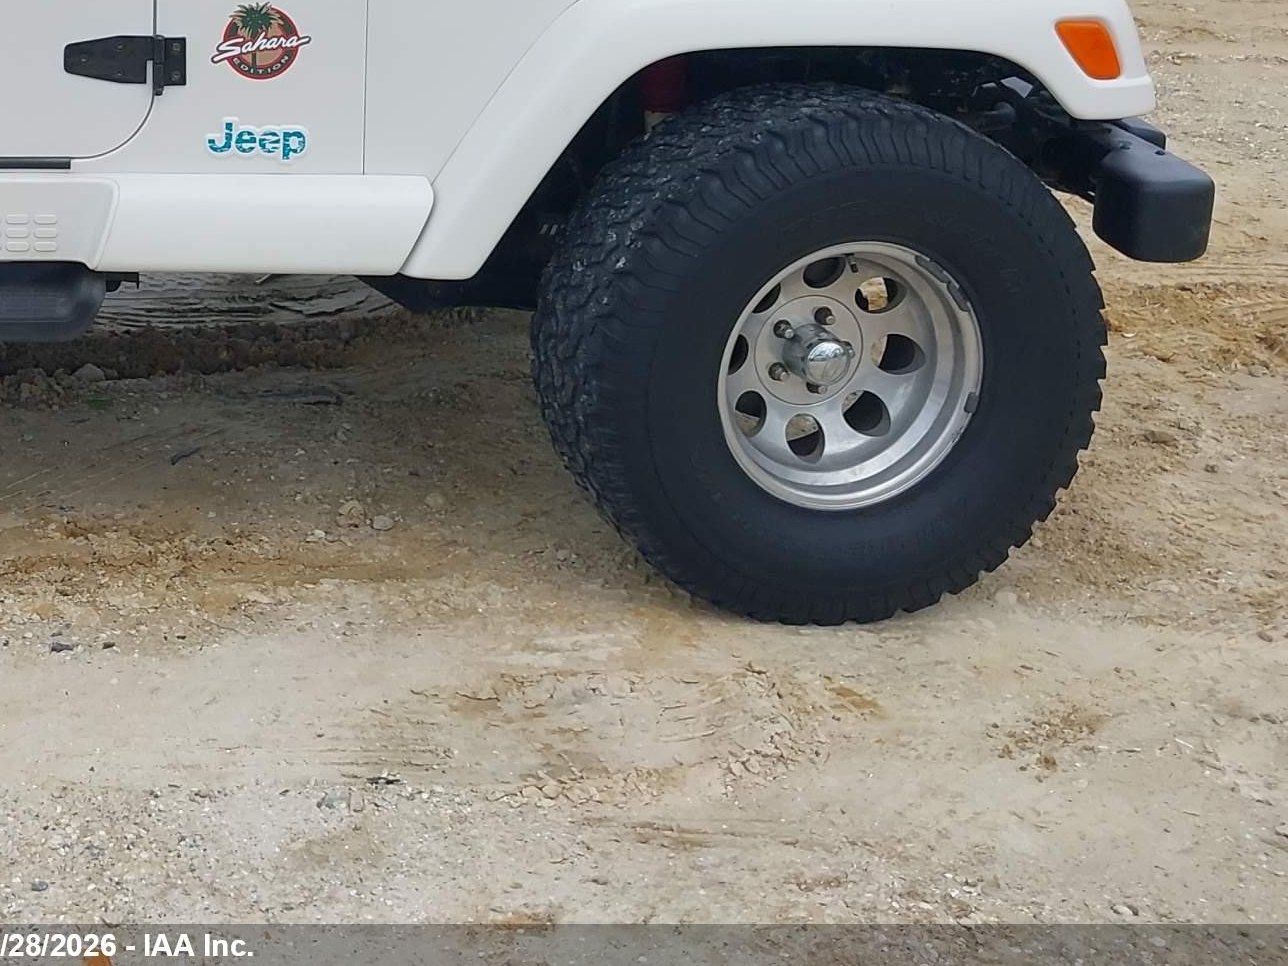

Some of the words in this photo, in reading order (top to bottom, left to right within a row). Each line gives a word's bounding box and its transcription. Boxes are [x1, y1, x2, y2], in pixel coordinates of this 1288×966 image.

[211, 32, 312, 64] Sahara
[232, 54, 290, 75] EDITION
[207, 121, 306, 160] Jeep
